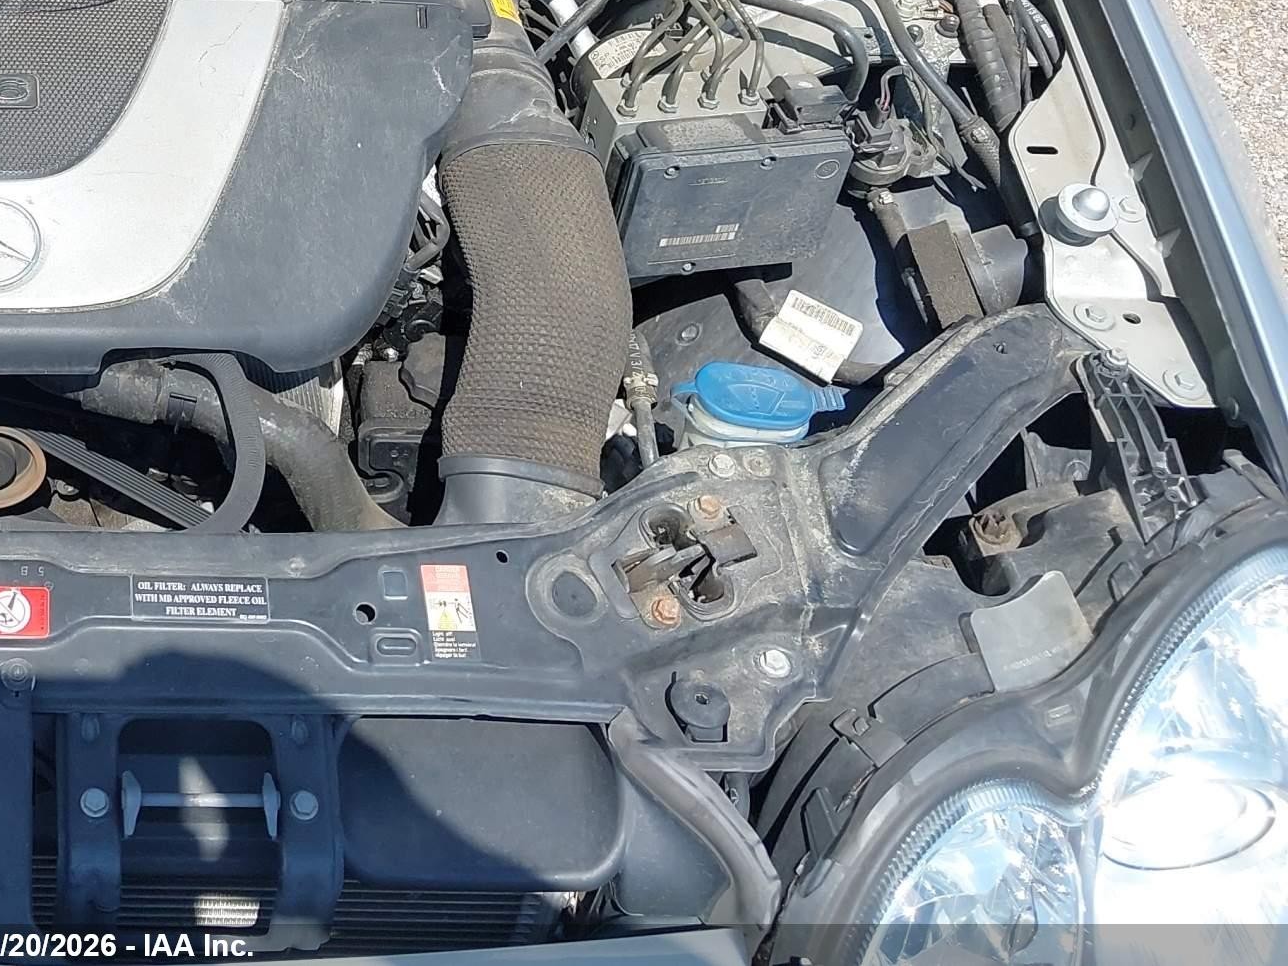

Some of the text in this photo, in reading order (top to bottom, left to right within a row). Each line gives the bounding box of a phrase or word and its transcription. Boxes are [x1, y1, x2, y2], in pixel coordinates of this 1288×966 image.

[137, 582, 263, 593] OIL FILTER: ALWAYS REPLACE
[134, 594, 267, 605] WITH MB APPROVED FLEECE OIL
[166, 606, 237, 617] FILTER ELEMENT
